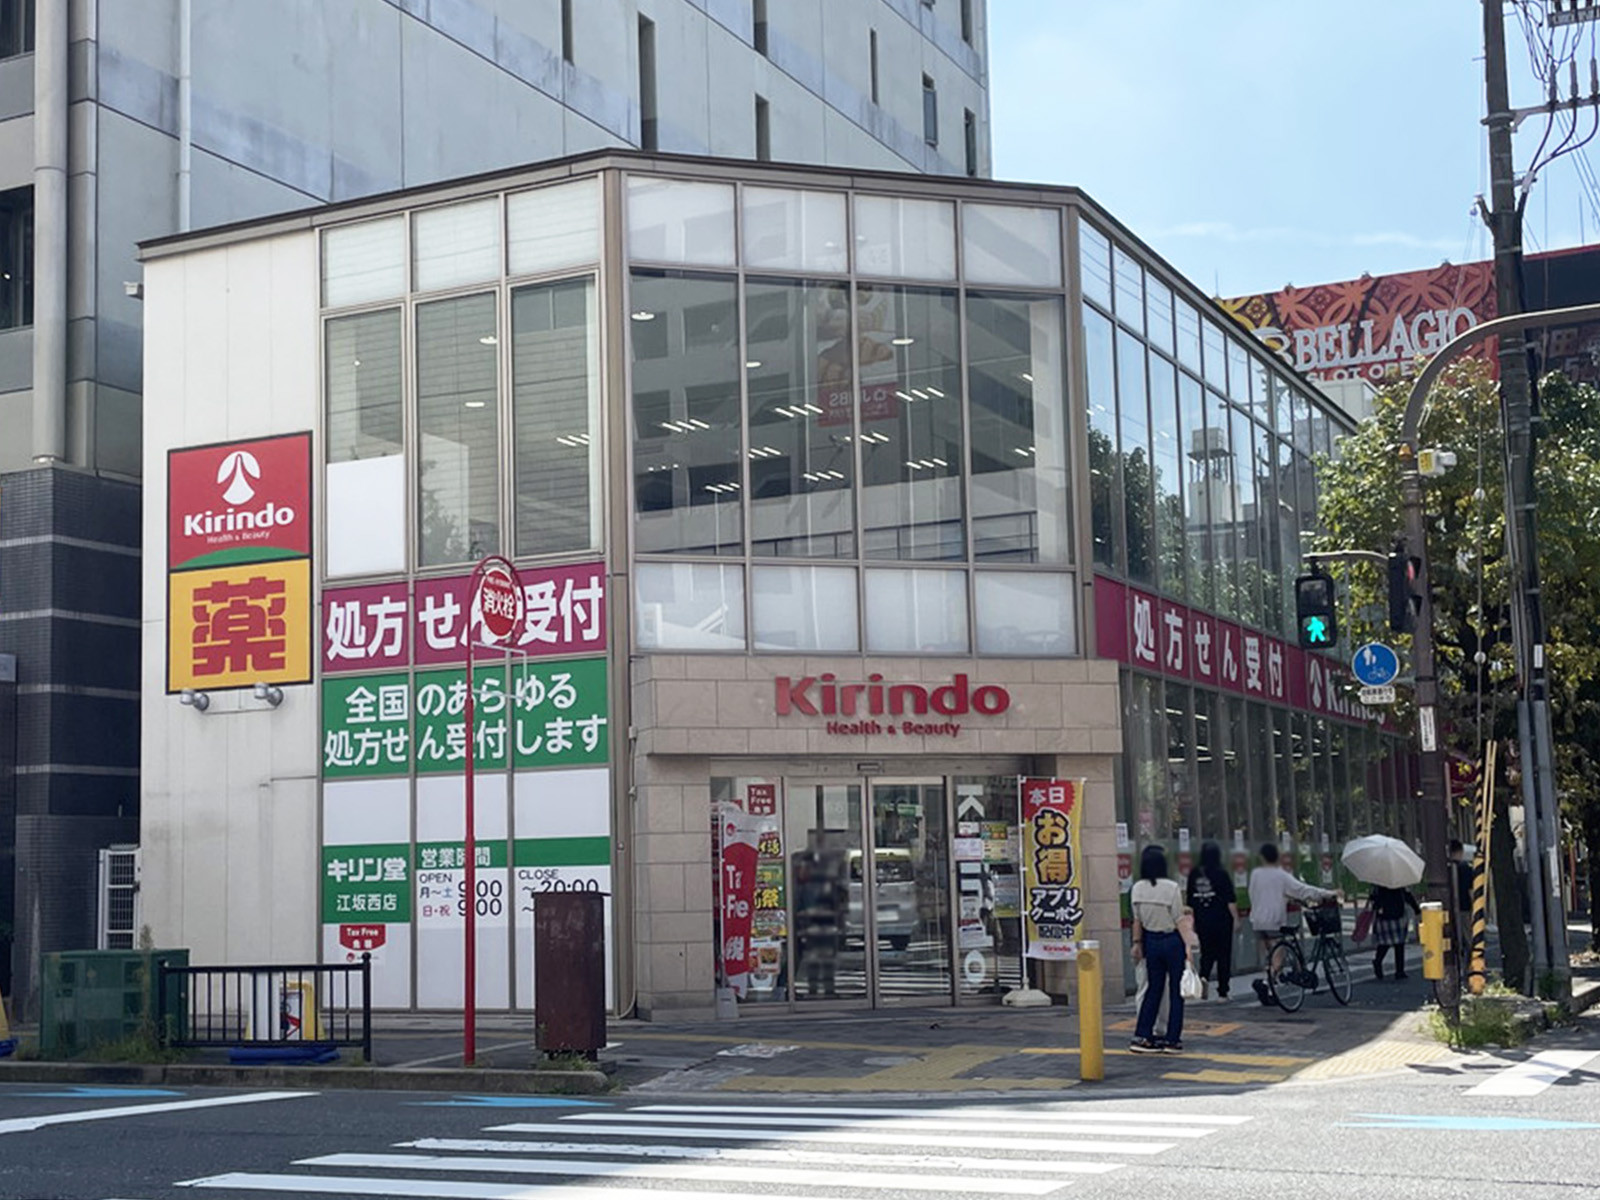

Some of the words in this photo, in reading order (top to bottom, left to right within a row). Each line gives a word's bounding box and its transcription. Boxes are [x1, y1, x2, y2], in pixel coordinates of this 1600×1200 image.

[1293, 307, 1477, 372] BELLAGIO
[1369, 360, 1415, 379] OPE
[184, 502, 295, 536] Kirindo
[483, 587, 515, 620] 消火栓
[192, 576, 286, 677] 薬
[1134, 595, 1283, 697] 処方せん受付
[775, 673, 1010, 716] Kirindo
[826, 720, 882, 736] Health
[902, 720, 960, 738] Beauty
[325, 714, 607, 768] 処方せん受付します
[1029, 786, 1065, 806] 本日
[1034, 808, 1072, 886] お得
[327, 857, 407, 882] キリン堂
[419, 873, 452, 884] OPEN
[518, 868, 559, 880] CLOSE
[458, 879, 502, 898] 900
[1031, 888, 1079, 906] アプリ
[336, 893, 397, 912] 江坂西店
[458, 898, 502, 917] 900
[1031, 906, 1082, 921] クーポン
